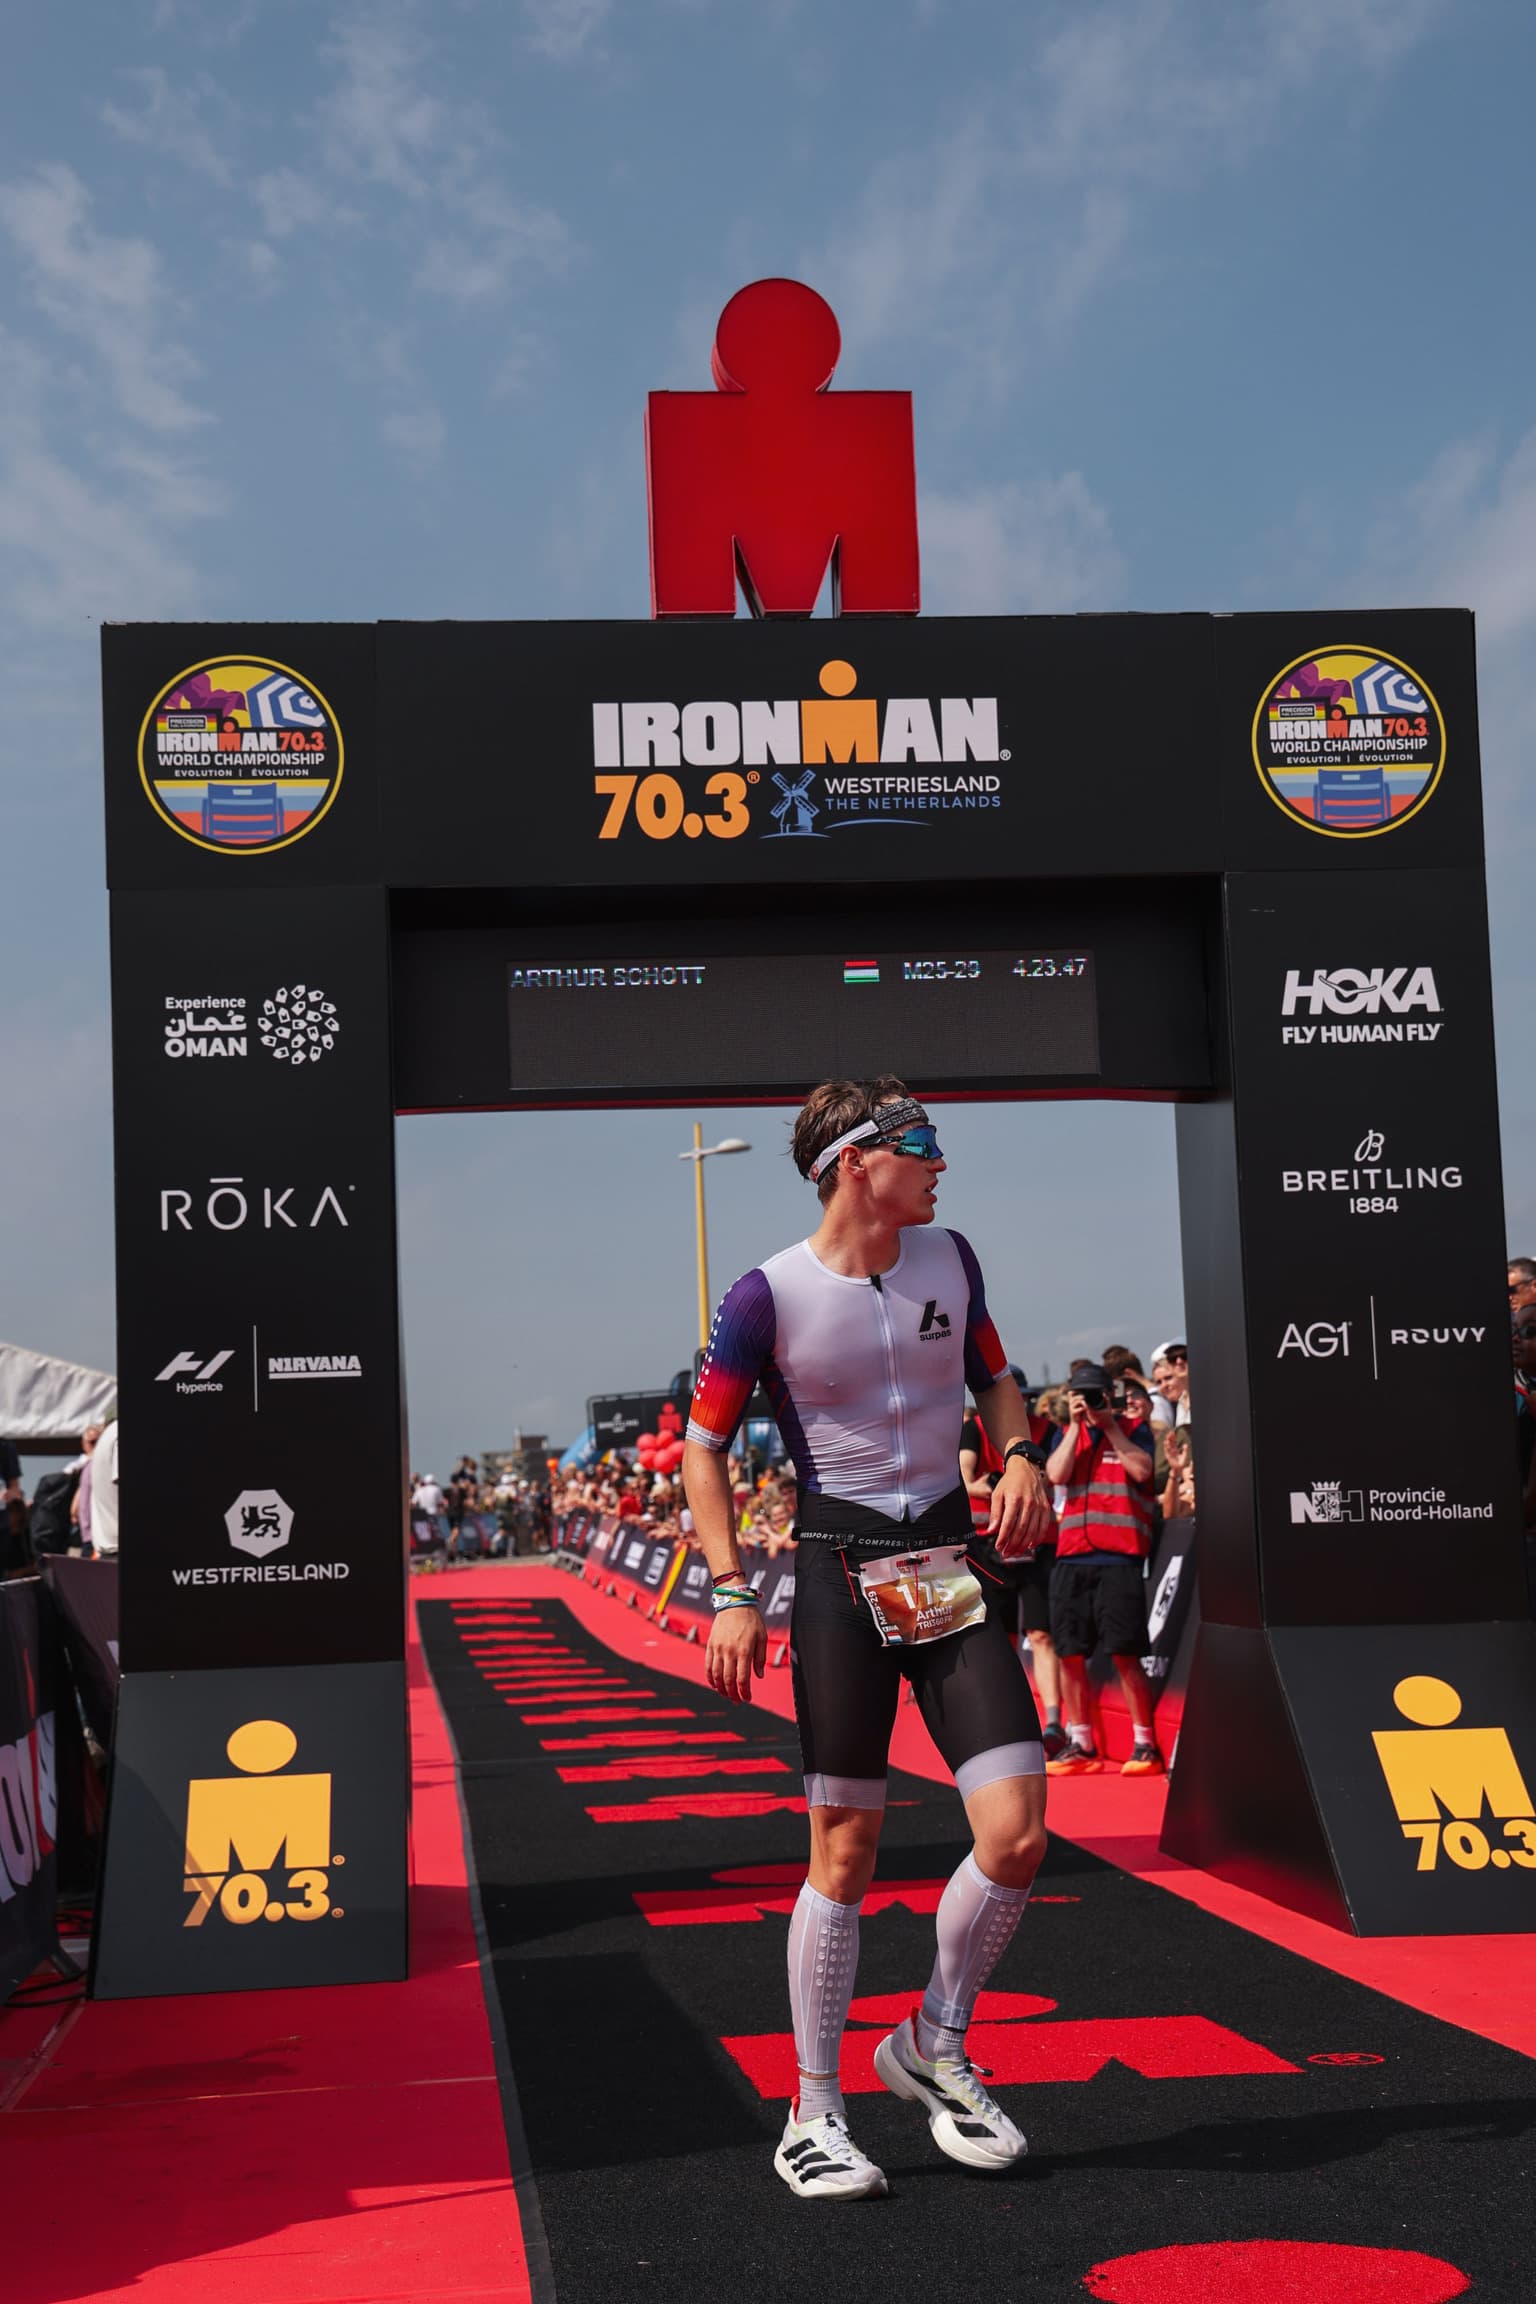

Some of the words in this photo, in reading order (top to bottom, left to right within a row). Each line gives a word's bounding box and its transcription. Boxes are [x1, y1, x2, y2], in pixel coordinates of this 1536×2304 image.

[1269, 718, 1383, 740] IRONMAN
[1384, 717, 1428, 737] 70.3
[157, 732, 277, 752] IRONMAN
[279, 731, 325, 750] 70.3
[1271, 741, 1320, 753] WORLD
[1324, 738, 1428, 752] CHAMPIONSHIP
[158, 754, 211, 766] WORLD
[214, 753, 325, 765] CHAMPIONSHIP
[1287, 756, 1341, 764] EVOLUTION
[1359, 753, 1413, 762] ÉVOLUTION
[251, 767, 309, 777] ÉVOLUTION
[824, 776, 1000, 794] WESTFRIESLAND
[825, 798, 860, 811] THE
[867, 796, 1001, 809] NETHERLANDS
[510, 968, 607, 987] ARTHUR
[613, 966, 706, 985] SCHOTT
[904, 961, 981, 980] M25-29
[1012, 958, 1088, 977] 4.23.47
[1281, 967, 1440, 1015] HOKA
[165, 996, 246, 1011] Experience
[1282, 1026, 1317, 1044] FLY
[1321, 1025, 1402, 1043] HUMAN
[1406, 1023, 1444, 1041] FLY
[164, 1037, 247, 1057] OMAN
[1282, 1167, 1462, 1192] BREITLING
[1350, 1197, 1398, 1213] 1884
[920, 1330, 951, 1341] surpas
[1277, 1322, 1349, 1358] AG1
[1391, 1327, 1486, 1344] ROUVY
[269, 1355, 361, 1372] NIRVANA
[176, 1381, 223, 1394] Hyperice
[1369, 1488, 1446, 1503] Provincie
[1370, 1503, 1493, 1521] Noord-Holland
[172, 1563, 349, 1585] WESTFRIESLAND
[896, 1578, 955, 1610] 175
[917, 1605, 953, 1621] Arthur
[1401, 1819, 1536, 1871] 70.3
[183, 1869, 330, 1927] 70.3
